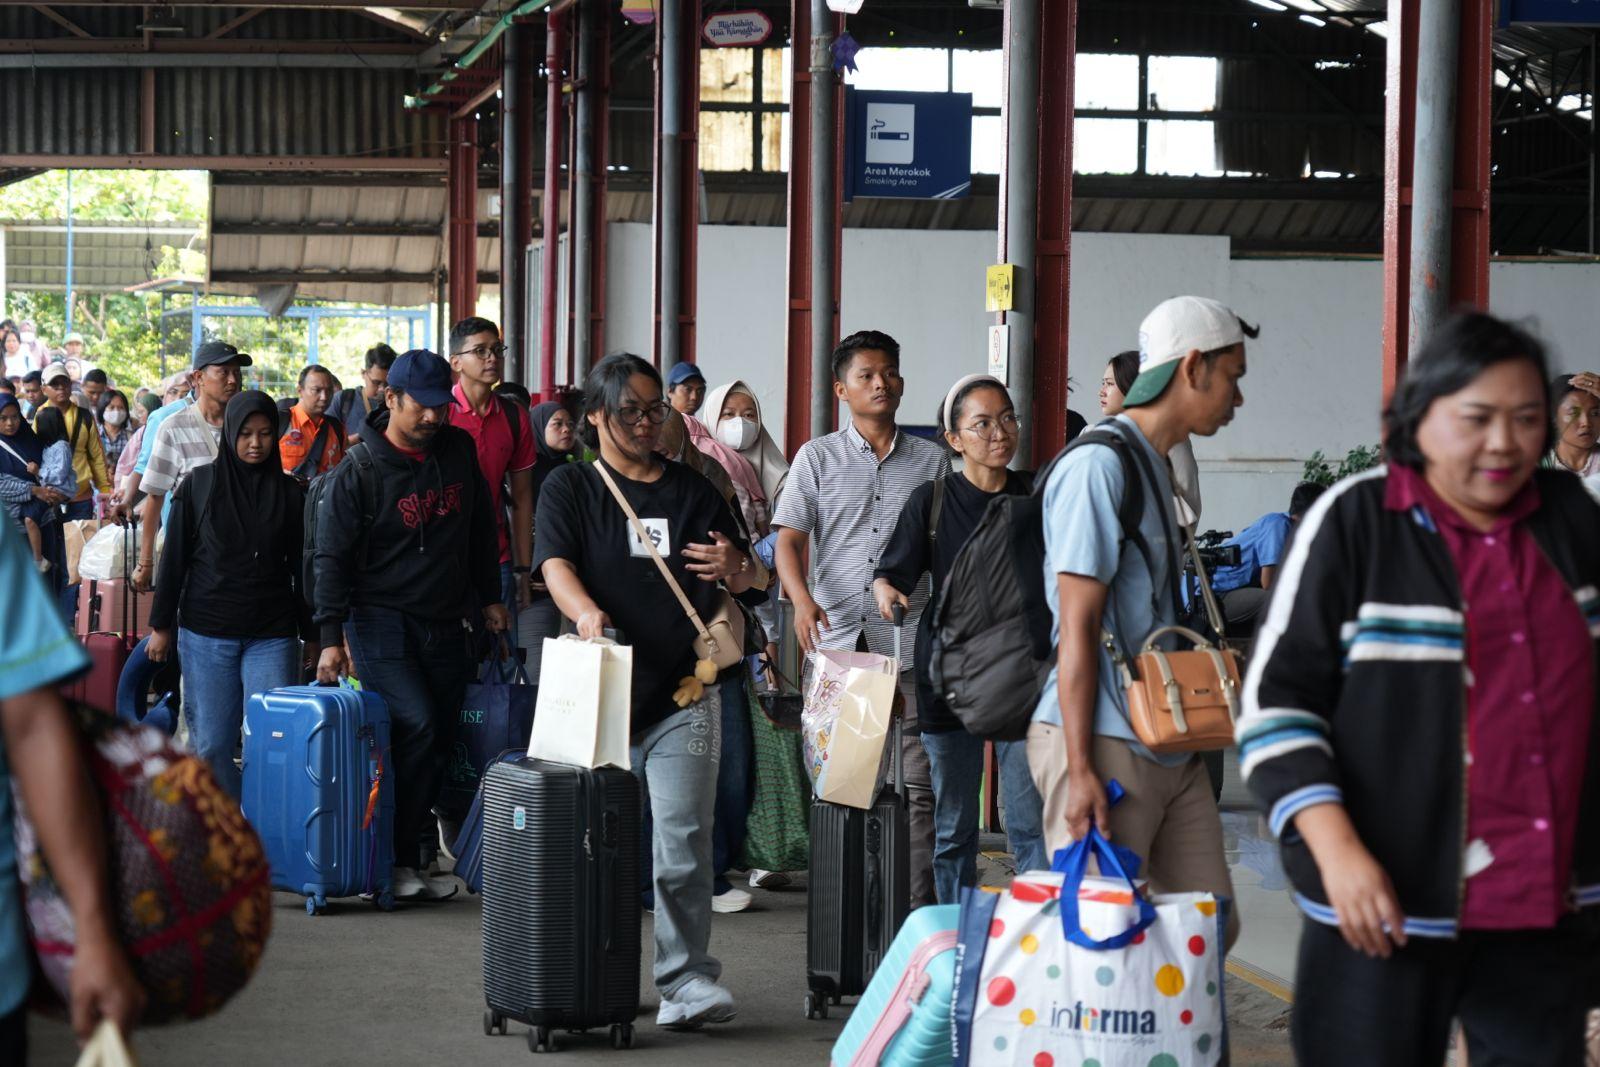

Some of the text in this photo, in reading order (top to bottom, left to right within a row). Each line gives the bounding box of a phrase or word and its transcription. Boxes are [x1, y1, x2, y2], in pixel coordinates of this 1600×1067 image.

[864, 166, 931, 177] Area Merokok
[864, 176, 917, 187] Smoking Area
[1051, 1000, 1156, 1034] informa
